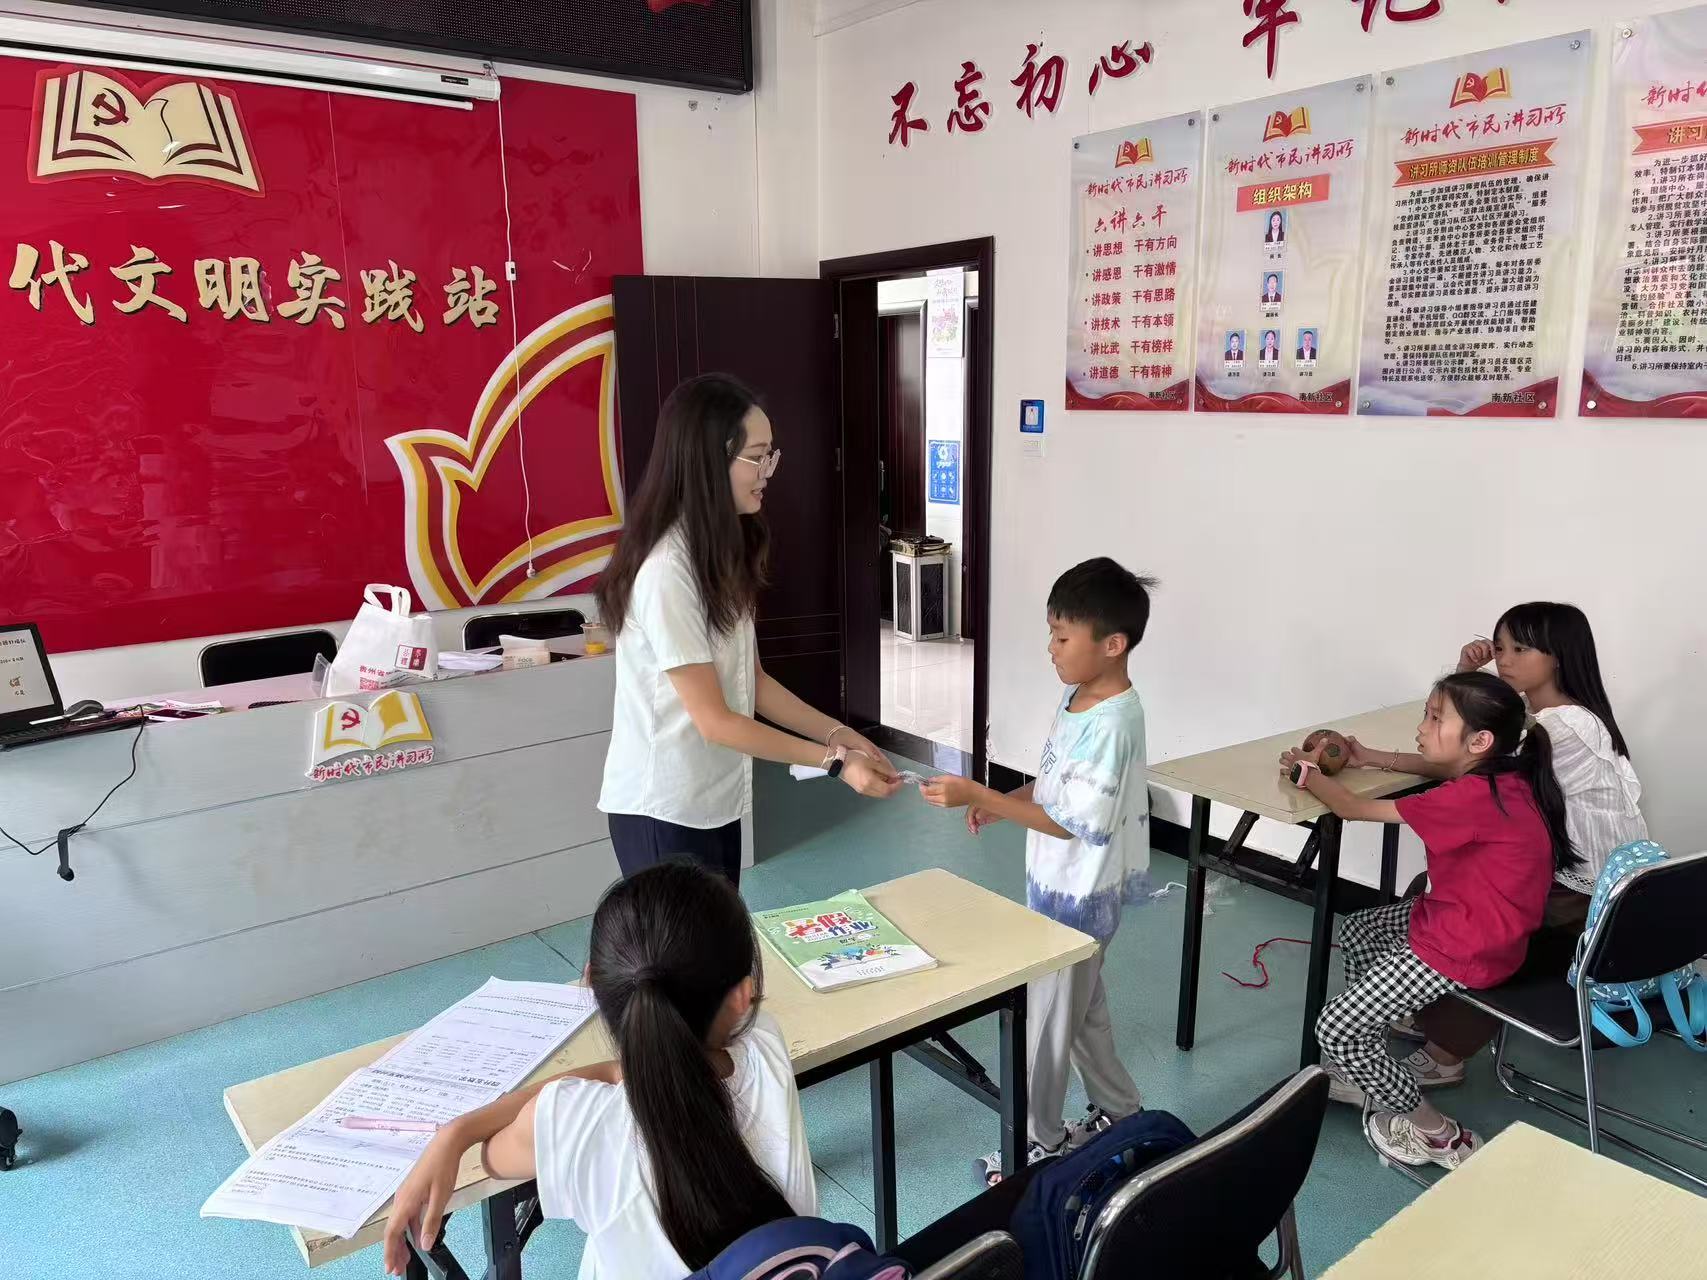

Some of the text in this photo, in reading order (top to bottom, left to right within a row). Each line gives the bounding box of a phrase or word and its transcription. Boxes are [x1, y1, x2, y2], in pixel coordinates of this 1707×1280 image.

[889, 40, 1153, 149] 不忘初心
[1400, 104, 1567, 147] 新时代市民讲习所
[1225, 138, 1354, 175] 新时代市民讲习所
[1410, 147, 1539, 179] 讲习所师资队伍培训管理制度
[1087, 167, 1188, 197] 新时代市民讲习所
[1252, 181, 1313, 205] 组织架构
[1094, 204, 1167, 234] 六讲六干
[1093, 235, 1178, 257] 讲思想 干有方向
[1092, 262, 1177, 281] 讲感恩 干有激情
[8, 239, 500, 332] 代文明实践站
[1091, 287, 1176, 306] 讲政策 干有思路
[1091, 313, 1175, 331] 讲技术 干有本领
[1090, 339, 1174, 355] 讲比武 干有榜样
[1089, 364, 1173, 379] 讲道德 干有精神
[1491, 392, 1535, 403] 南新社区
[313, 748, 433, 780] 新时代市民讲习所
